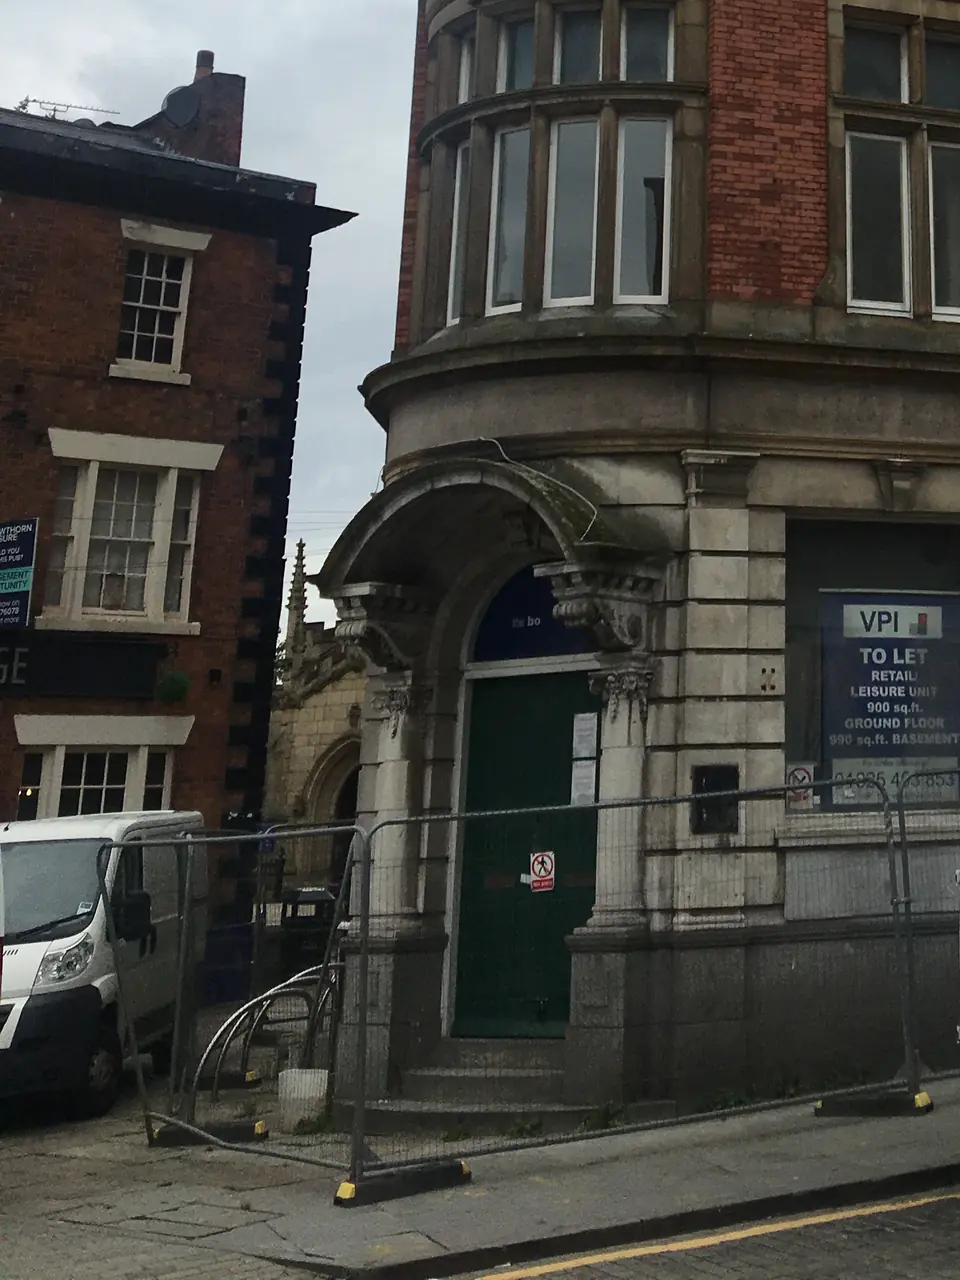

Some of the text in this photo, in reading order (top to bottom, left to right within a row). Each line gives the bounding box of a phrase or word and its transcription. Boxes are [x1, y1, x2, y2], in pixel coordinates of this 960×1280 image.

[859, 610, 899, 633] VPI
[859, 647, 928, 665] TO LET
[850, 686, 938, 698] LEISURE UNIT
[867, 701, 891, 713] 900
[844, 718, 945, 729] GROUND FLOOR
[892, 733, 960, 745] BASEMENT
